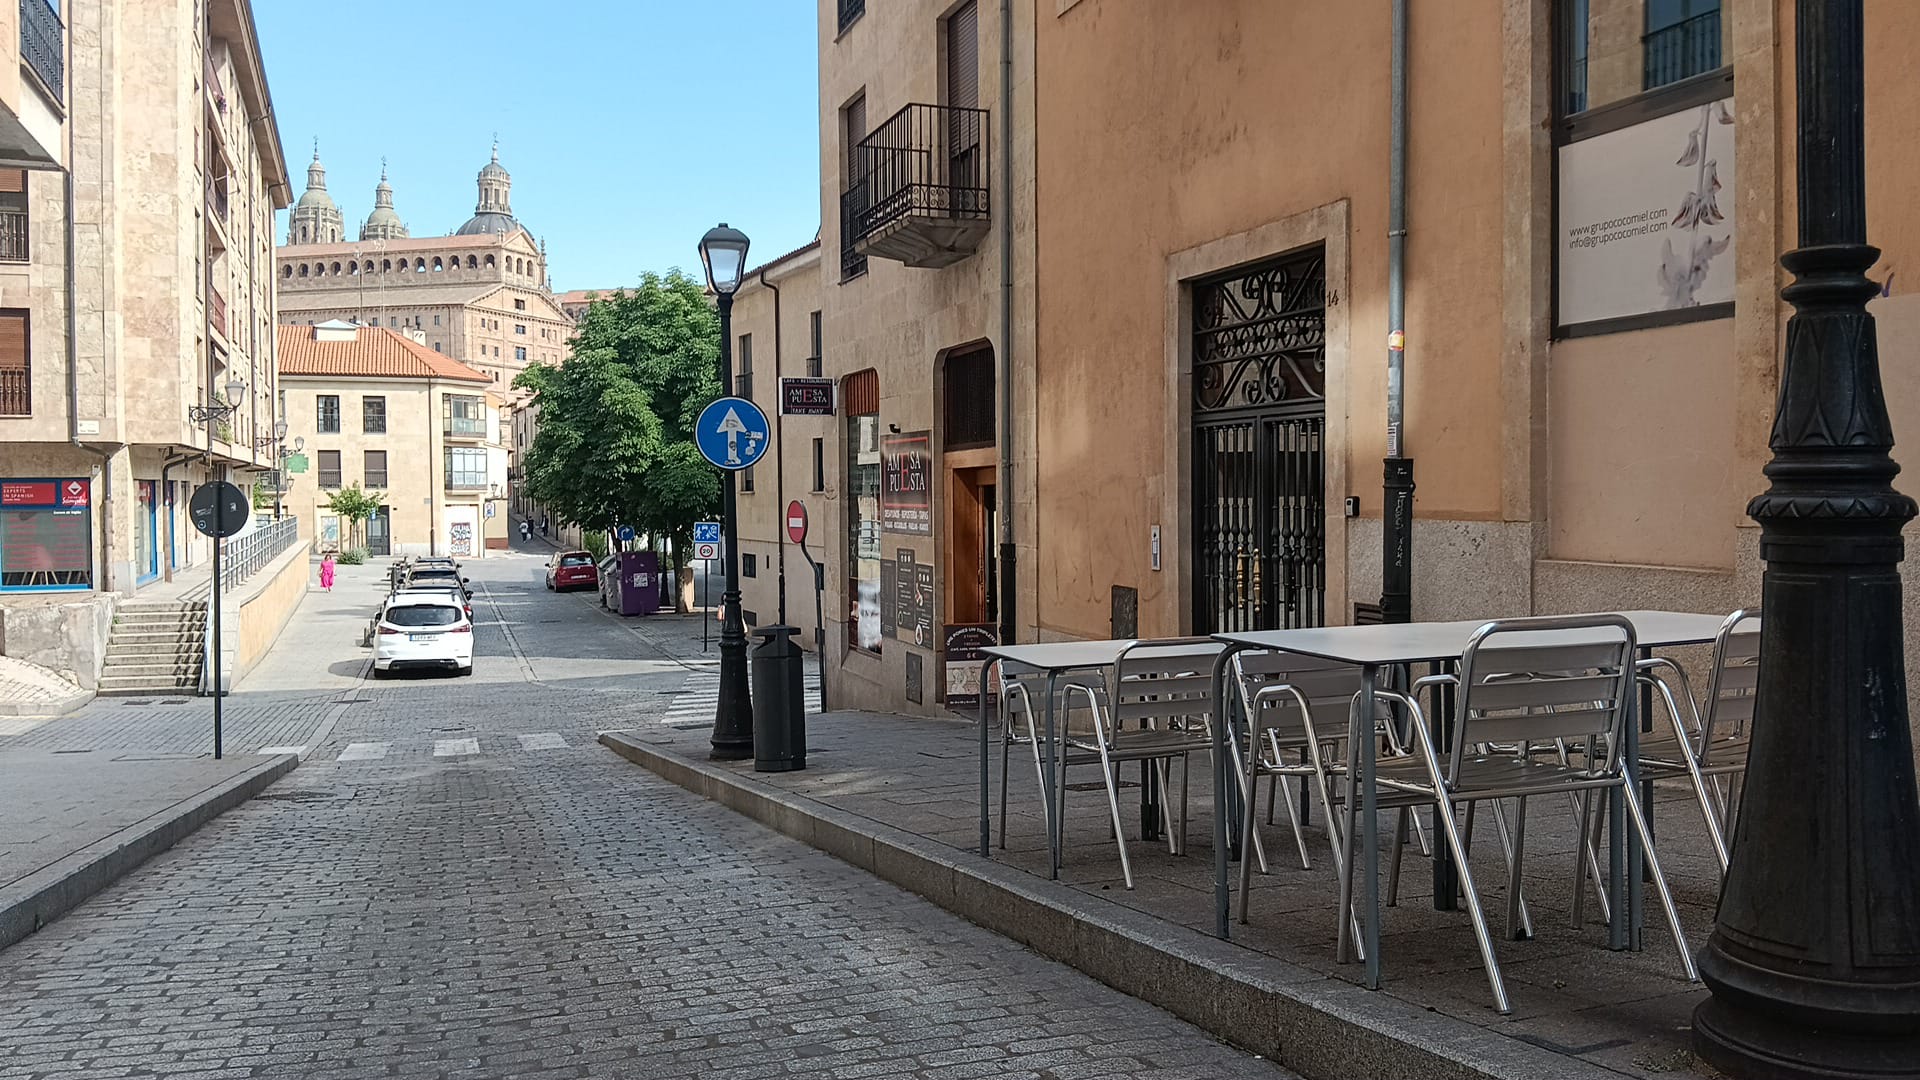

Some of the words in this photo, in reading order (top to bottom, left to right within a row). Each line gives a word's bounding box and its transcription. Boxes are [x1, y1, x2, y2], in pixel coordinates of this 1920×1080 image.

[1569, 208, 1668, 237] www.grupococomiel.com
[1569, 221, 1668, 249] info@grupococomiel.com
[1326, 289, 1340, 307] 14
